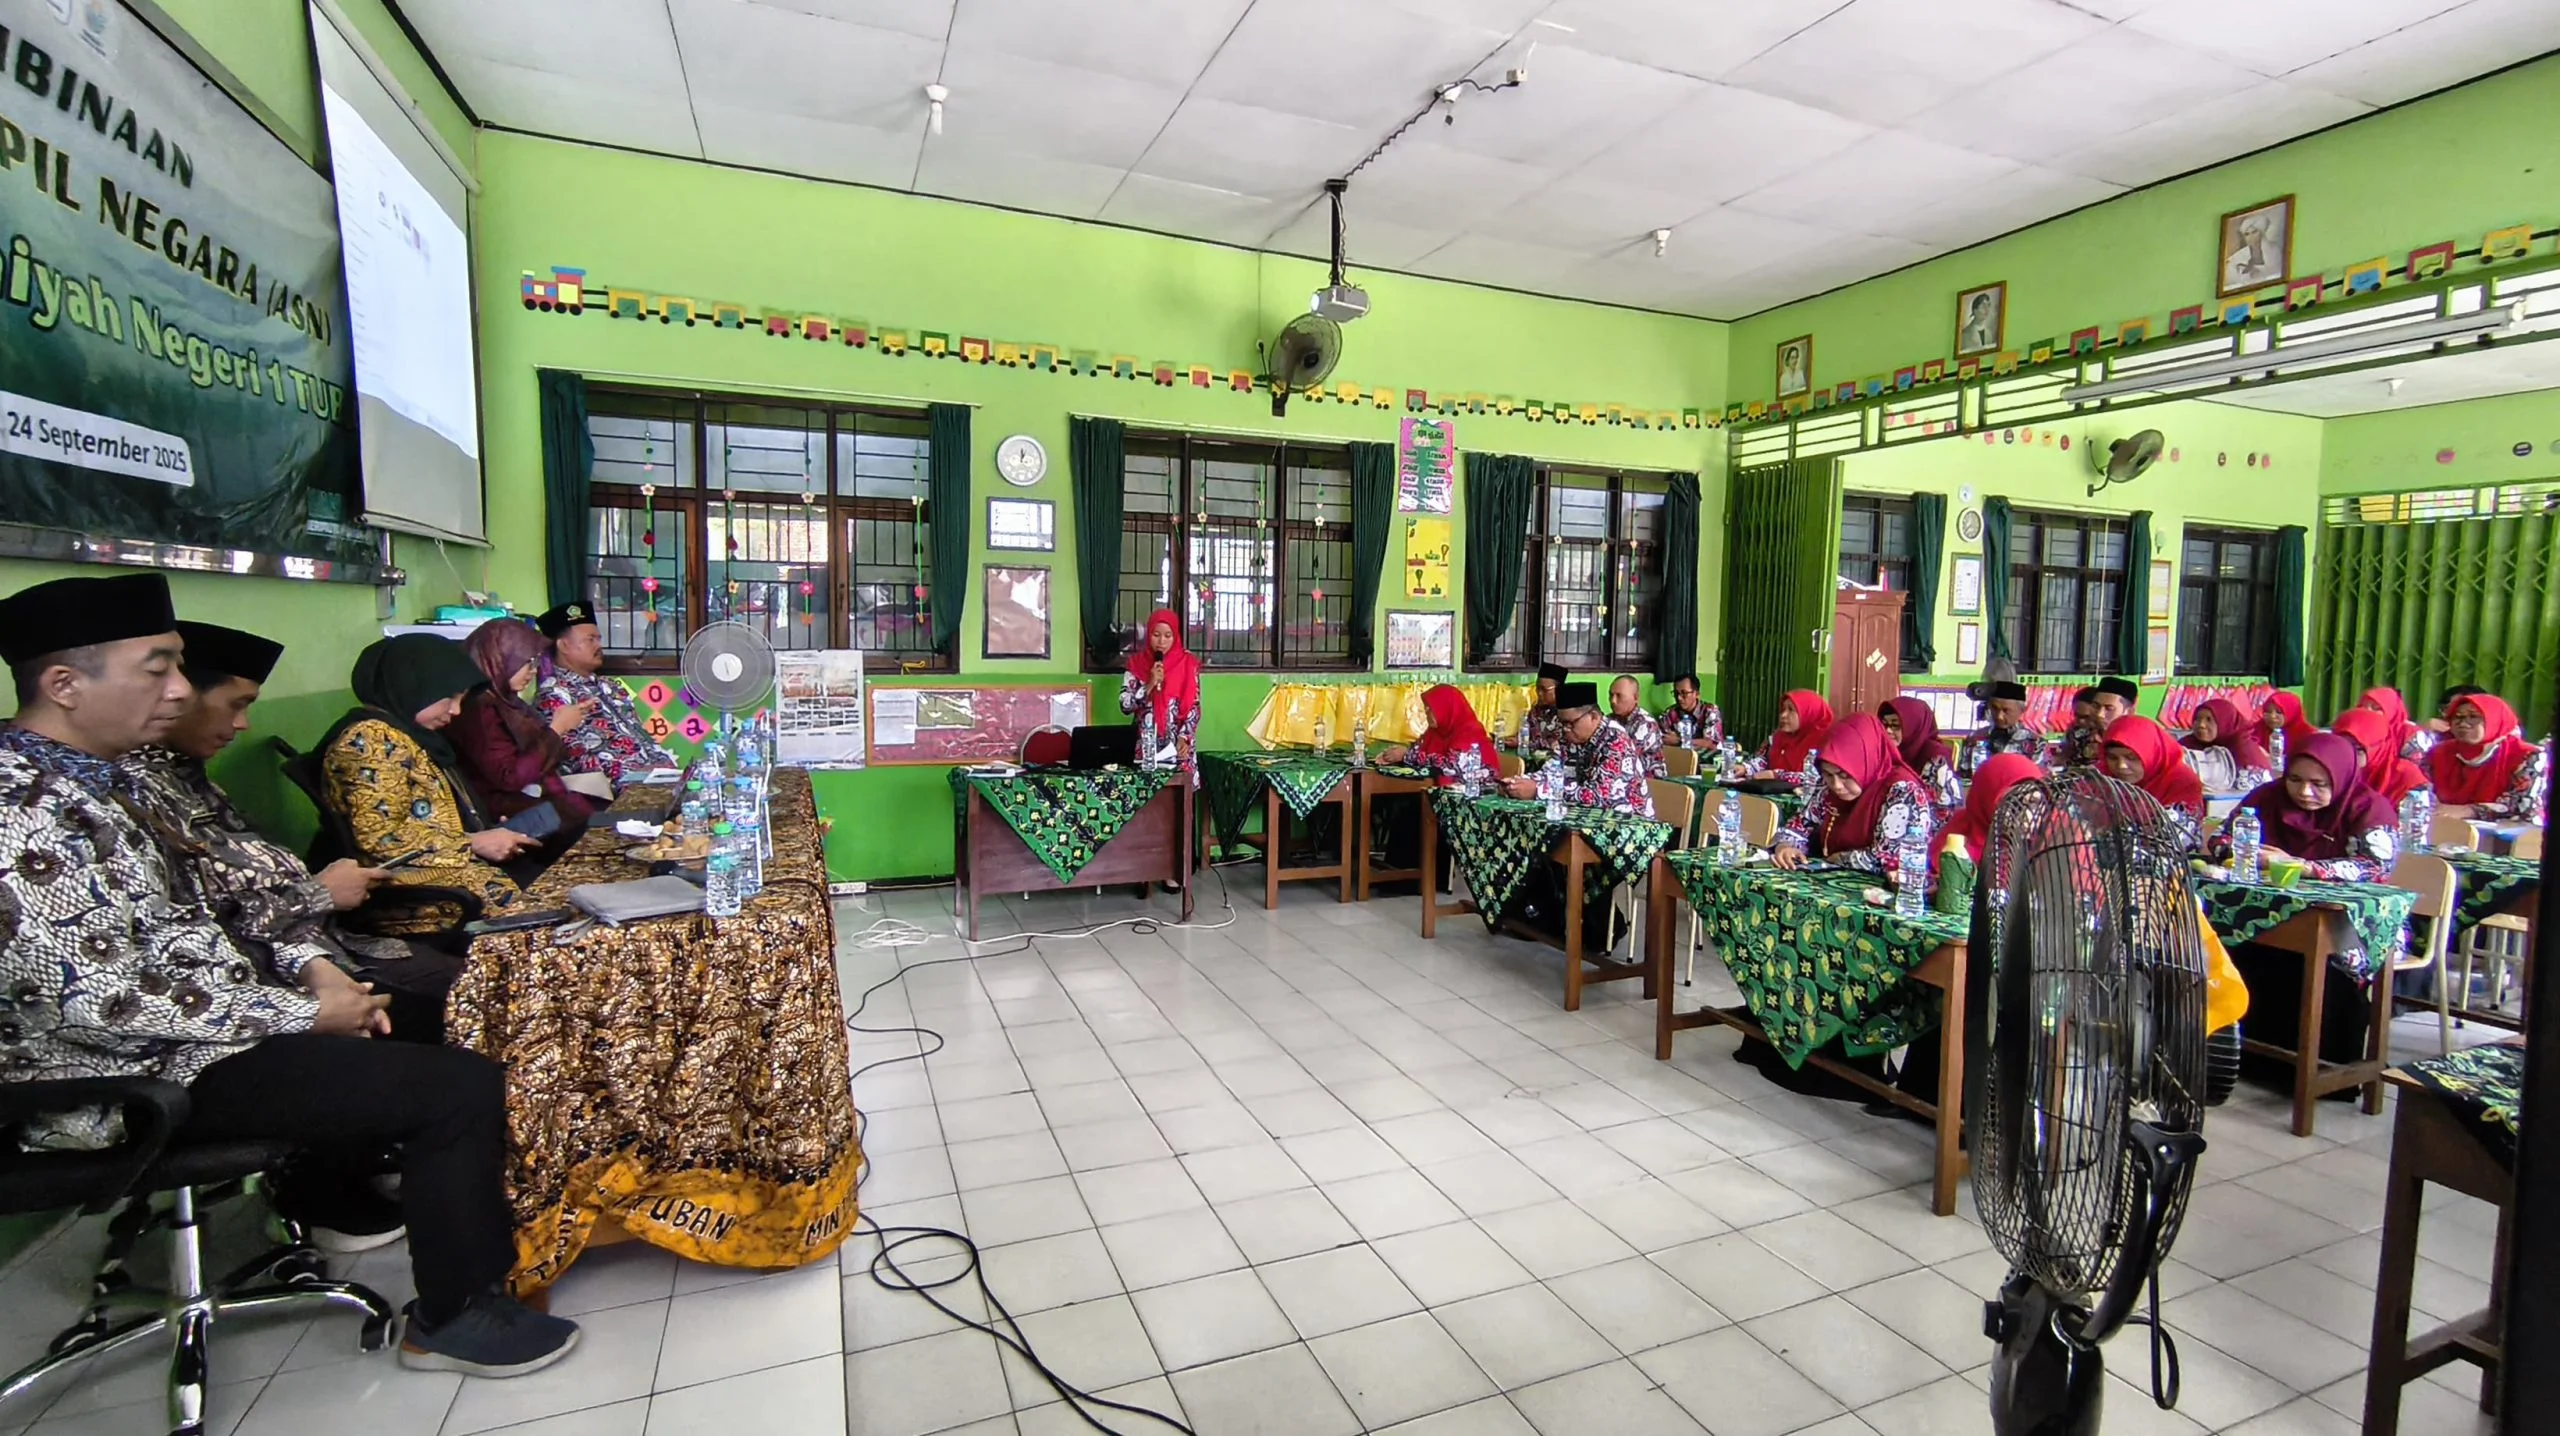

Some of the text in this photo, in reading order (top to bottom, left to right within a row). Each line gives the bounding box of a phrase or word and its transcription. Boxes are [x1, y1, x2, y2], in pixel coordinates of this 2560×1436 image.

[0, 234, 124, 345] iyah
[130, 295, 262, 397] Negeri
[266, 357, 286, 404] 1
[100, 176, 257, 305] NEGARA
[267, 279, 331, 347] (ASN)
[7, 411, 188, 473] 24 September 2025
